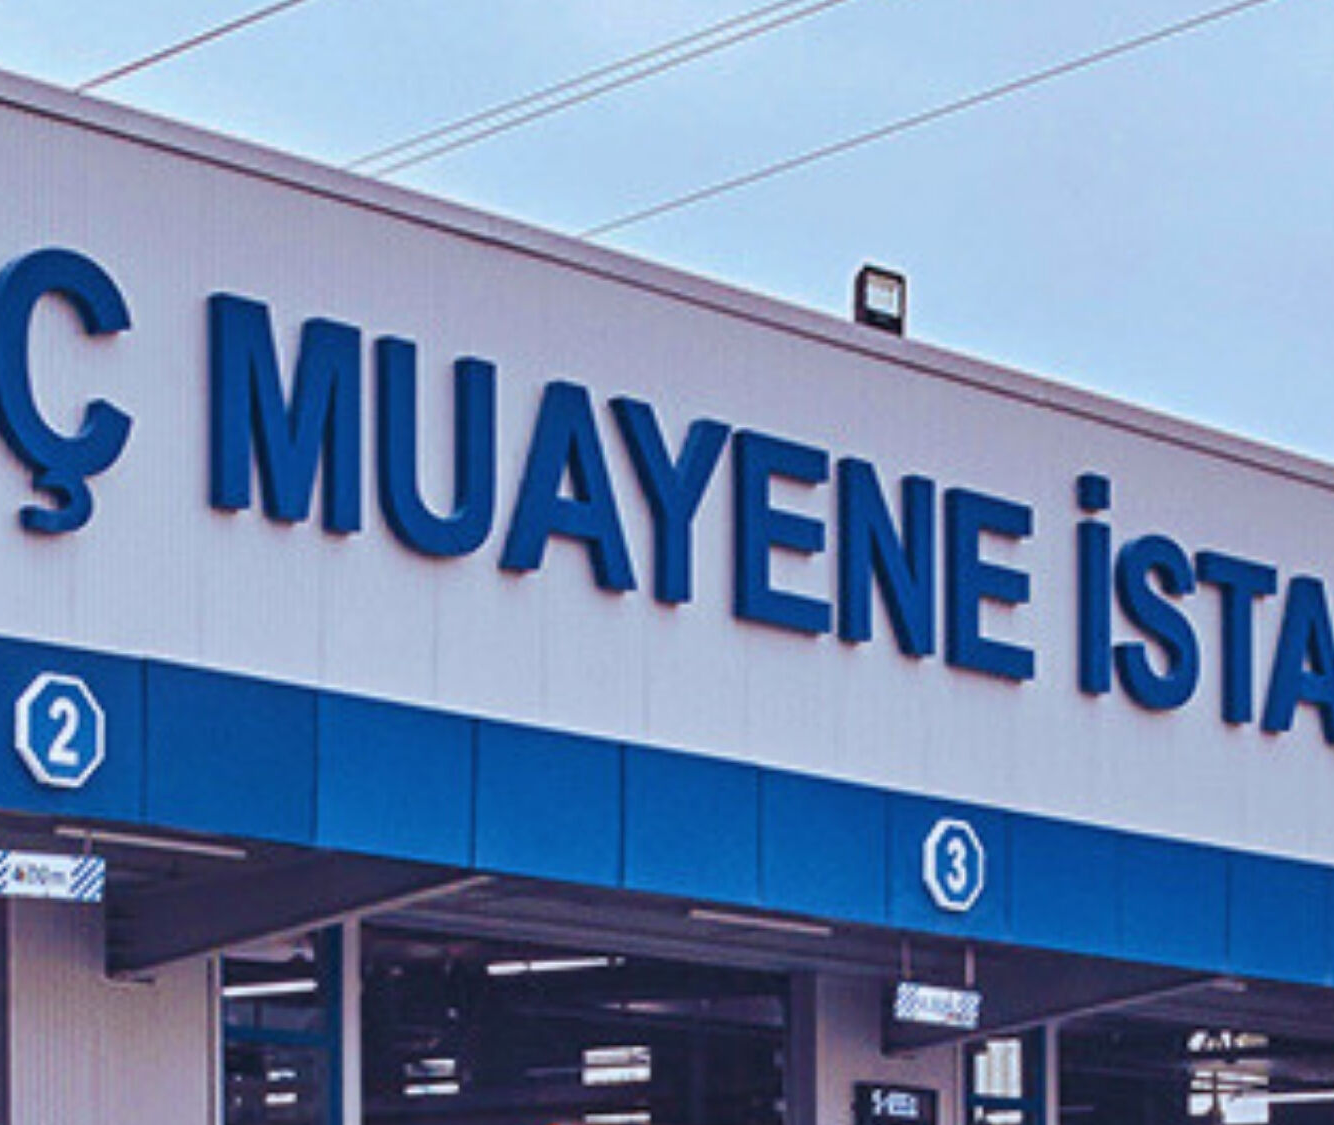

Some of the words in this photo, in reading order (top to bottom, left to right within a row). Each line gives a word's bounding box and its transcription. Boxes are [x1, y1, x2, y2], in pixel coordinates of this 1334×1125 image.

[209, 292, 1035, 680] MUAYENE
[48, 697, 79, 766] 2
[946, 837, 967, 894] 3
